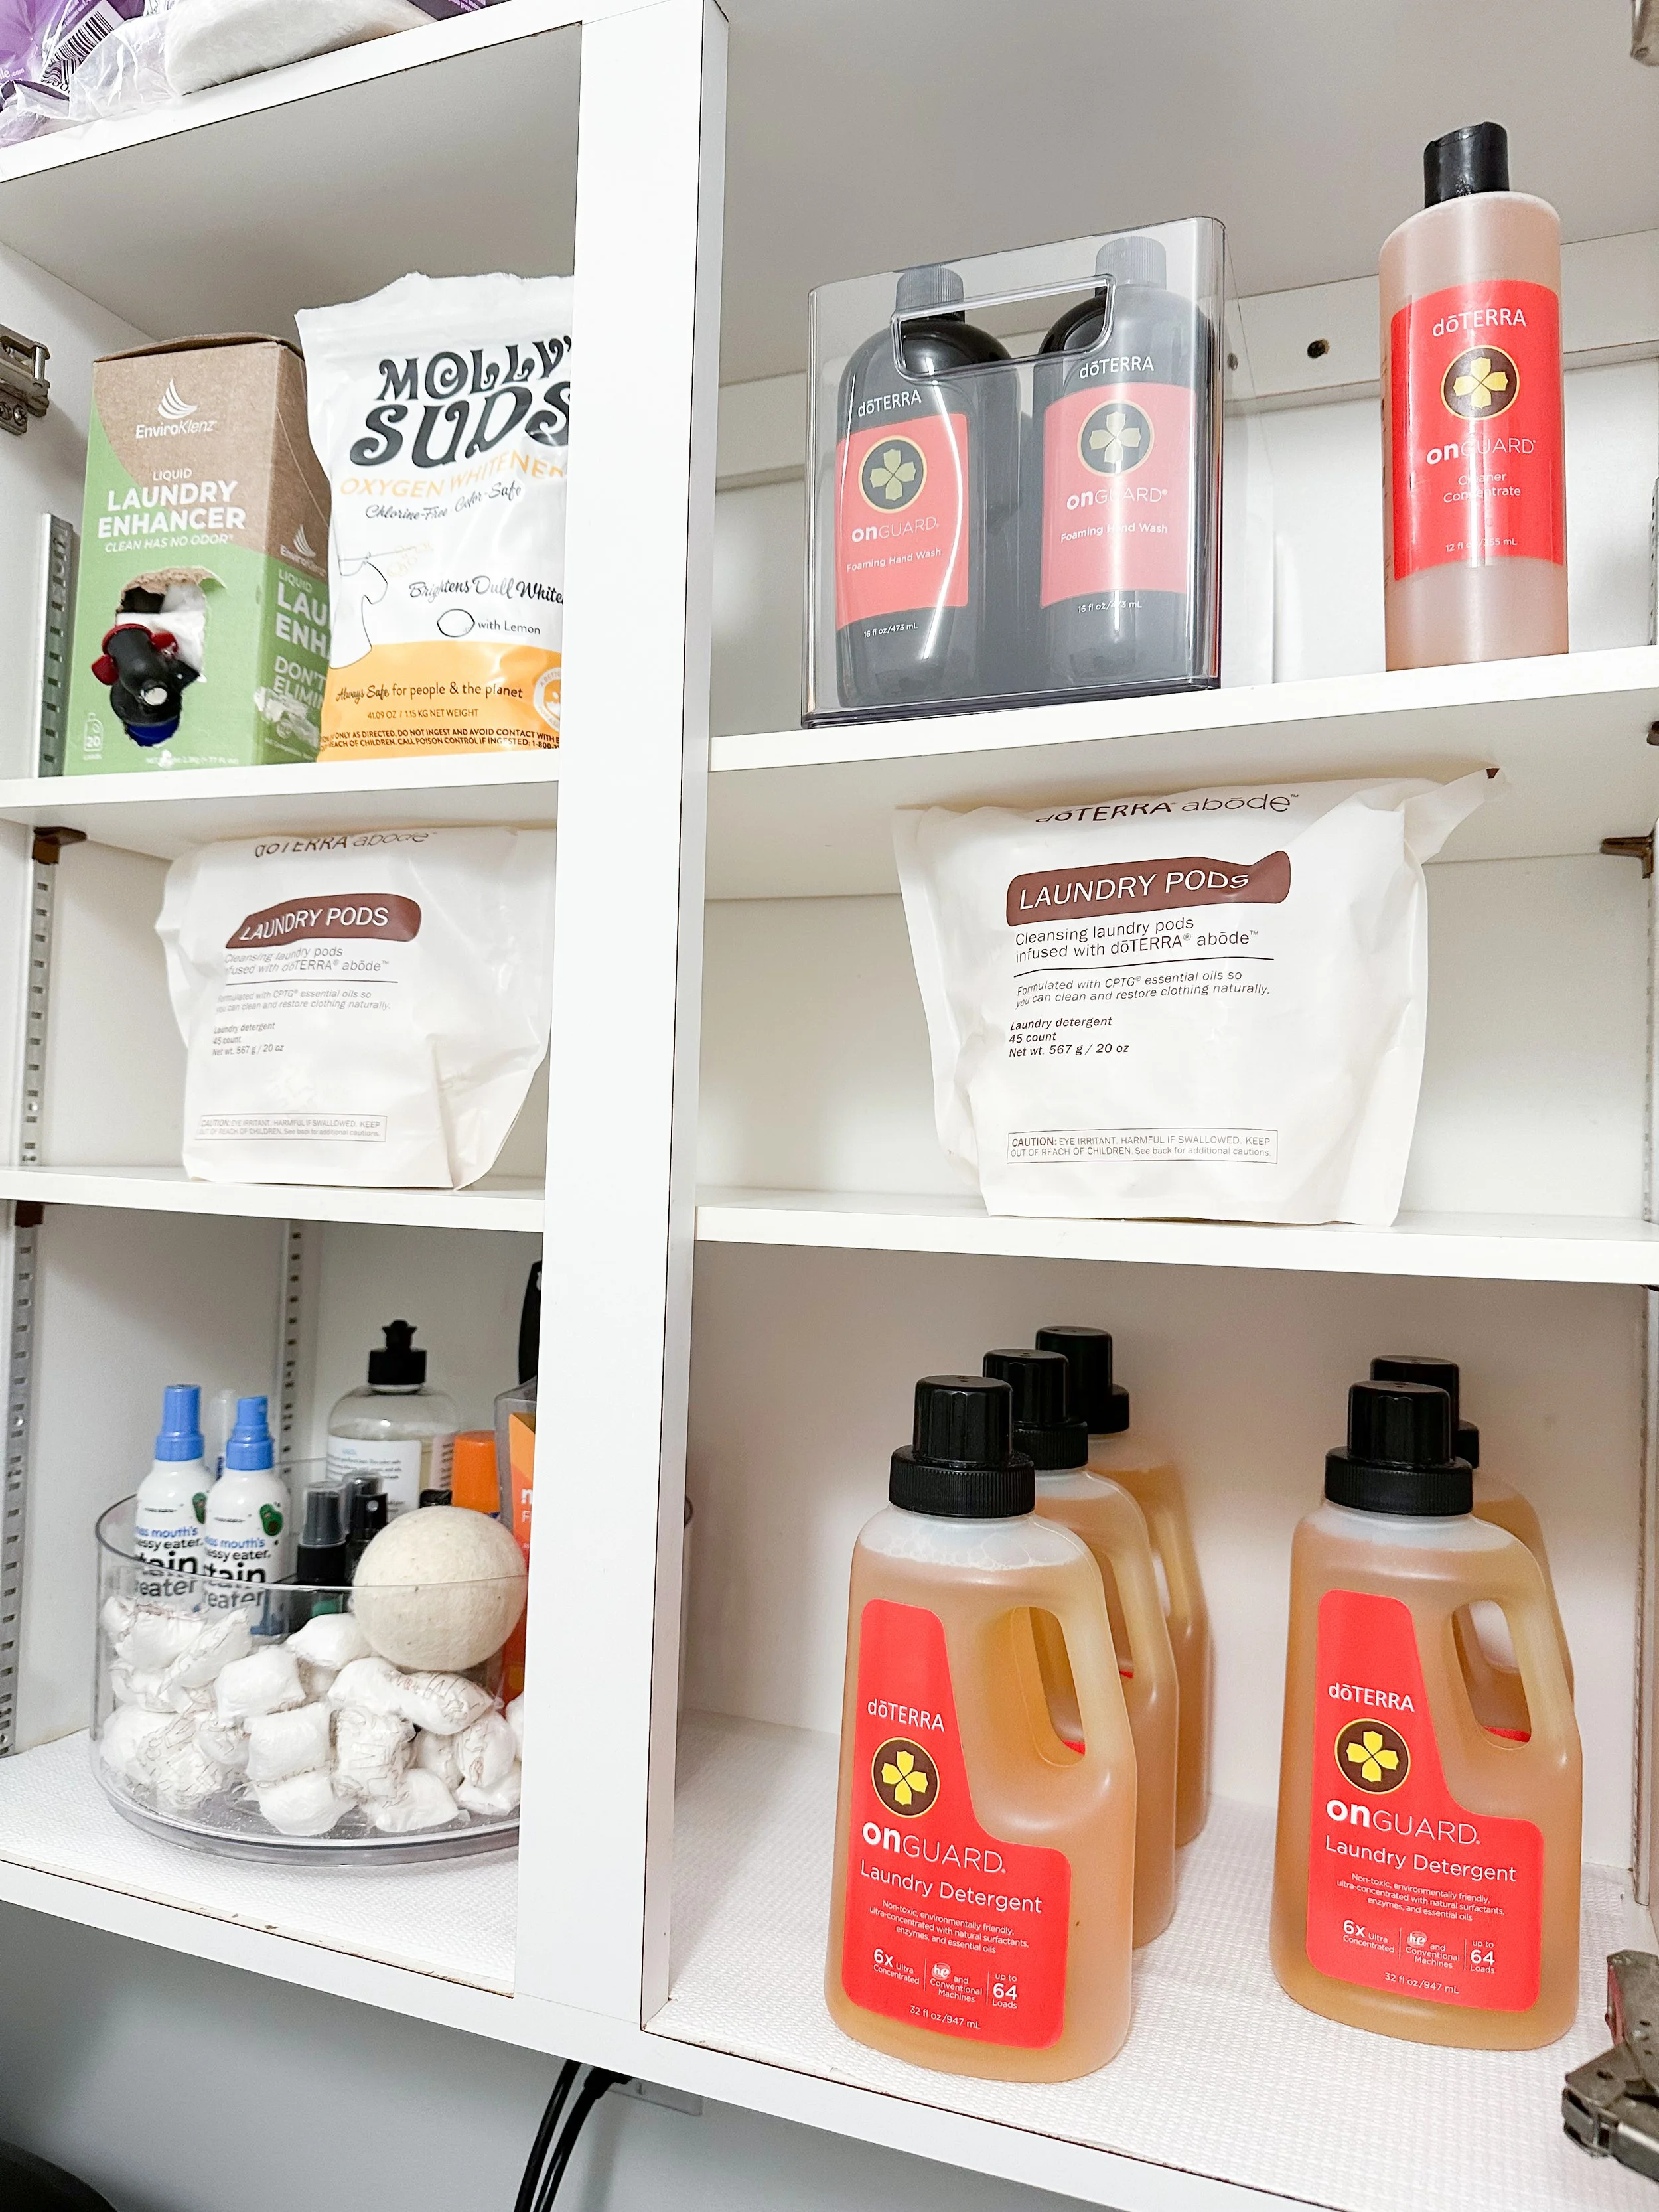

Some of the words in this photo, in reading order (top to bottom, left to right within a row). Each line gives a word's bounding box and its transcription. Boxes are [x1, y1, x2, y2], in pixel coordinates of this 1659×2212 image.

[135, 420, 217, 439] EnviroKlenz
[350, 381, 571, 468] SUDS
[153, 467, 192, 482] LIQUID
[108, 480, 238, 512] LAUNDRY
[340, 477, 443, 498] OXYGEN
[98, 507, 246, 539] ENHANCER
[1060, 524, 1103, 543] Foaming
[1107, 522, 1135, 534] Hnd
[1138, 523, 1168, 534] Wash
[105, 540, 141, 553] CLEAN
[144, 537, 168, 549] HAS
[171, 535, 188, 547] NO
[846, 557, 885, 573] Foaming
[889, 553, 913, 566] Hand
[916, 548, 942, 560] Wash
[409, 579, 470, 603] Brightens
[472, 575, 514, 599] Dull
[478, 619, 500, 631] with
[505, 620, 540, 634] Lemon
[366, 684, 390, 701] Safe
[392, 683, 408, 697] for
[410, 682, 445, 700] people
[449, 681, 459, 694] &
[463, 682, 481, 694] the
[486, 683, 523, 699] planet
[368, 711, 384, 720] 41.09
[386, 710, 397, 719] OZ
[418, 709, 429, 718] KG
[430, 709, 445, 718] NET
[447, 708, 479, 717] WEIGHT
[362, 729, 397, 738] DIRECTED.
[427, 728, 451, 737] INGEST
[496, 728, 535, 739] CONTACT
[536, 731, 555, 743] WITH
[1019, 873, 1157, 911] LAUNDRY
[1165, 869, 1250, 894] PODS
[240, 907, 323, 941] LAUNDRY
[326, 907, 390, 927] PODS
[1015, 928, 1088, 947] Cleansing
[1093, 922, 1149, 942] laundry
[1155, 917, 1194, 934] pods
[276, 948, 311, 962] laundry
[313, 946, 344, 959] pods
[1015, 944, 1068, 964] infused
[1074, 942, 1105, 958] with
[258, 962, 279, 974] with
[1017, 980, 1074, 997] Formulated
[1077, 979, 1100, 990] with
[1145, 971, 1199, 985] essential
[1202, 970, 1224, 982] oils
[1227, 971, 1242, 981] so
[1015, 997, 1030, 1011] you
[1031, 993, 1051, 1004] can
[1054, 992, 1086, 1002] clean
[1090, 990, 1112, 1001] and
[1116, 987, 1157, 1000] restore
[1160, 985, 1208, 999] clothing
[1212, 984, 1271, 997] naturally.
[1010, 1018, 1052, 1031] Laundry
[1055, 1016, 1113, 1029] detergent
[1009, 1033, 1023, 1045] 45
[1025, 1031, 1056, 1043] count
[1009, 1047, 1027, 1059] Net
[1029, 1046, 1045, 1057] wt.
[1049, 1044, 1072, 1055] 567
[1075, 1045, 1083, 1057] g
[1096, 1043, 1113, 1054] 20
[1116, 1043, 1130, 1054] oz
[1011, 1137, 1058, 1147] CAUTION:
[1059, 1137, 1075, 1146] EYE
[1077, 1137, 1118, 1145] IRRITANT.
[1121, 1136, 1165, 1145] HARMFUL
[1167, 1136, 1175, 1144] IF
[1177, 1136, 1243, 1145] SWALLOWED.
[1245, 1136, 1271, 1146] KEEP
[151, 1526, 198, 1538] mouth's
[220, 1538, 265, 1548] mouth's
[1328, 1682, 1415, 1712] dōTERRA
[867, 1698, 945, 1732] dōTERRA
[1325, 1835, 1407, 1870] Laundry
[1413, 1854, 1517, 1882] Detergent
[861, 1859, 933, 1897] Laundry
[939, 1881, 1043, 1914] Detergent
[869, 1906, 935, 1931] ultra-concentrated
[936, 1925, 953, 1935] with
[954, 1929, 981, 1941] natural
[883, 1899, 919, 1917] Non-toxic,
[920, 1911, 981, 1931] environmentally
[1343, 1919, 1365, 1938] 6x
[896, 1925, 930, 1941] enzymes,
[931, 1935, 946, 1945] and
[948, 1939, 981, 1951] essential
[983, 1944, 996, 1953] oils
[873, 1948, 894, 1968] 6x
[896, 1962, 914, 1974] Ultra
[1470, 1949, 1495, 1966] 64
[873, 1964, 921, 1985] Concentrated
[953, 1974, 969, 1984] and
[995, 1973, 1006, 1982] up
[1470, 1964, 1495, 1974] Loads
[930, 1978, 983, 1996] Conventional
[993, 1982, 1019, 2001] 64
[1384, 1972, 1396, 1982] 32
[1398, 1975, 1405, 1985] fl
[1407, 1977, 1443, 1991] oz/947
[1445, 1984, 1460, 1994] mL
[938, 1988, 975, 2003] Machines
[992, 1999, 1018, 2010] Loads
[909, 2005, 921, 2016] 32
[922, 2007, 929, 2018] fl
[930, 2012, 964, 2026] oz/947
[966, 2019, 981, 2029] mL
